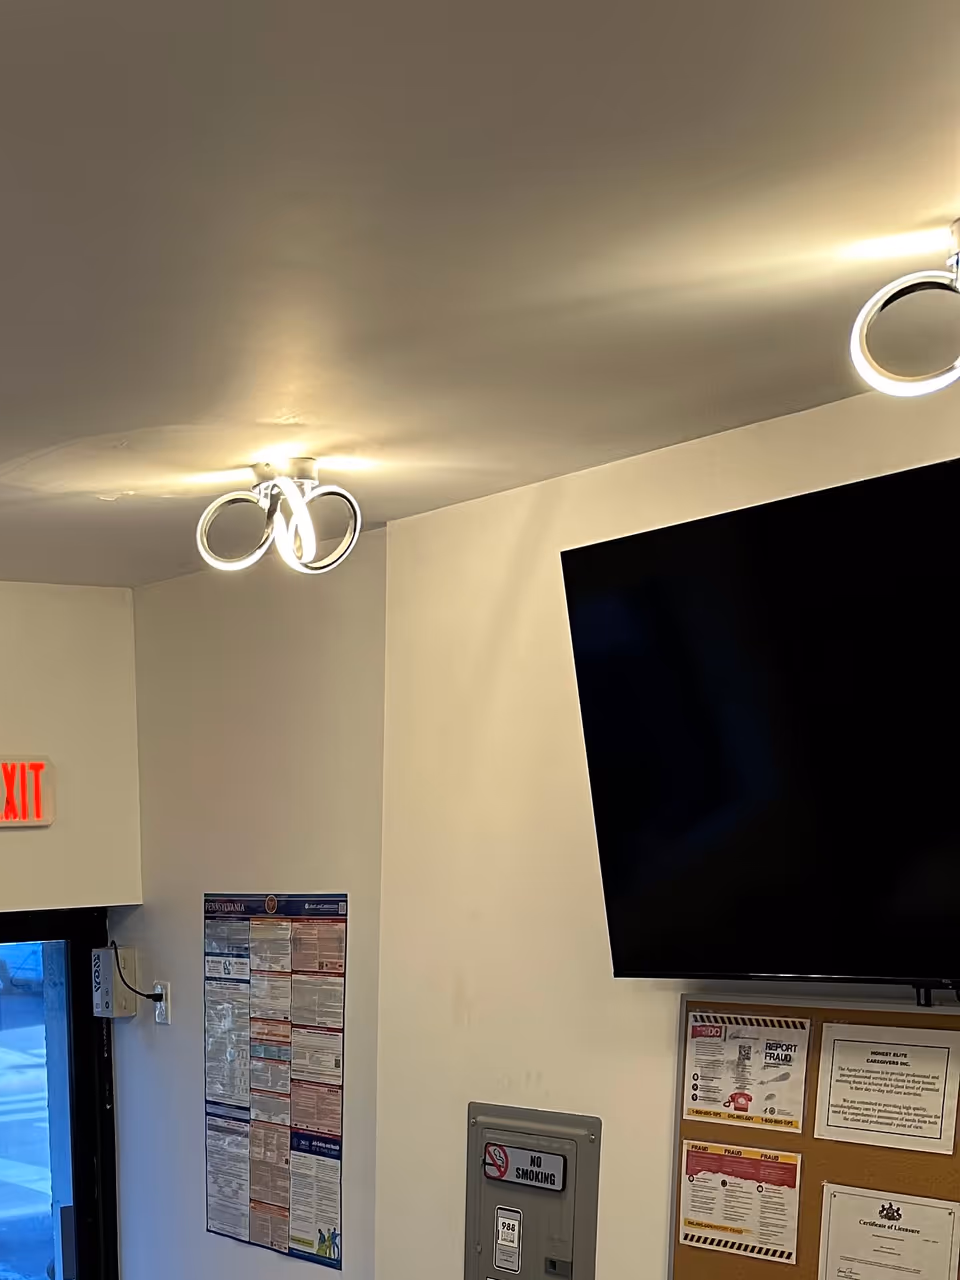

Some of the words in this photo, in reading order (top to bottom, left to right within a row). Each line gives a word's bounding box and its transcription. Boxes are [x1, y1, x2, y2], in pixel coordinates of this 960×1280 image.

[205, 902, 245, 911] PENNSYLVANIA
[708, 1028, 720, 1036] DO
[765, 1042, 798, 1053] REPORT
[764, 1052, 792, 1062] FRAUD
[530, 1155, 542, 1168] NO
[516, 1167, 556, 1185] SMOKING
[502, 1222, 516, 1232] 988
[859, 1219, 886, 1228] Certificate
[894, 1225, 920, 1234] Licensure
